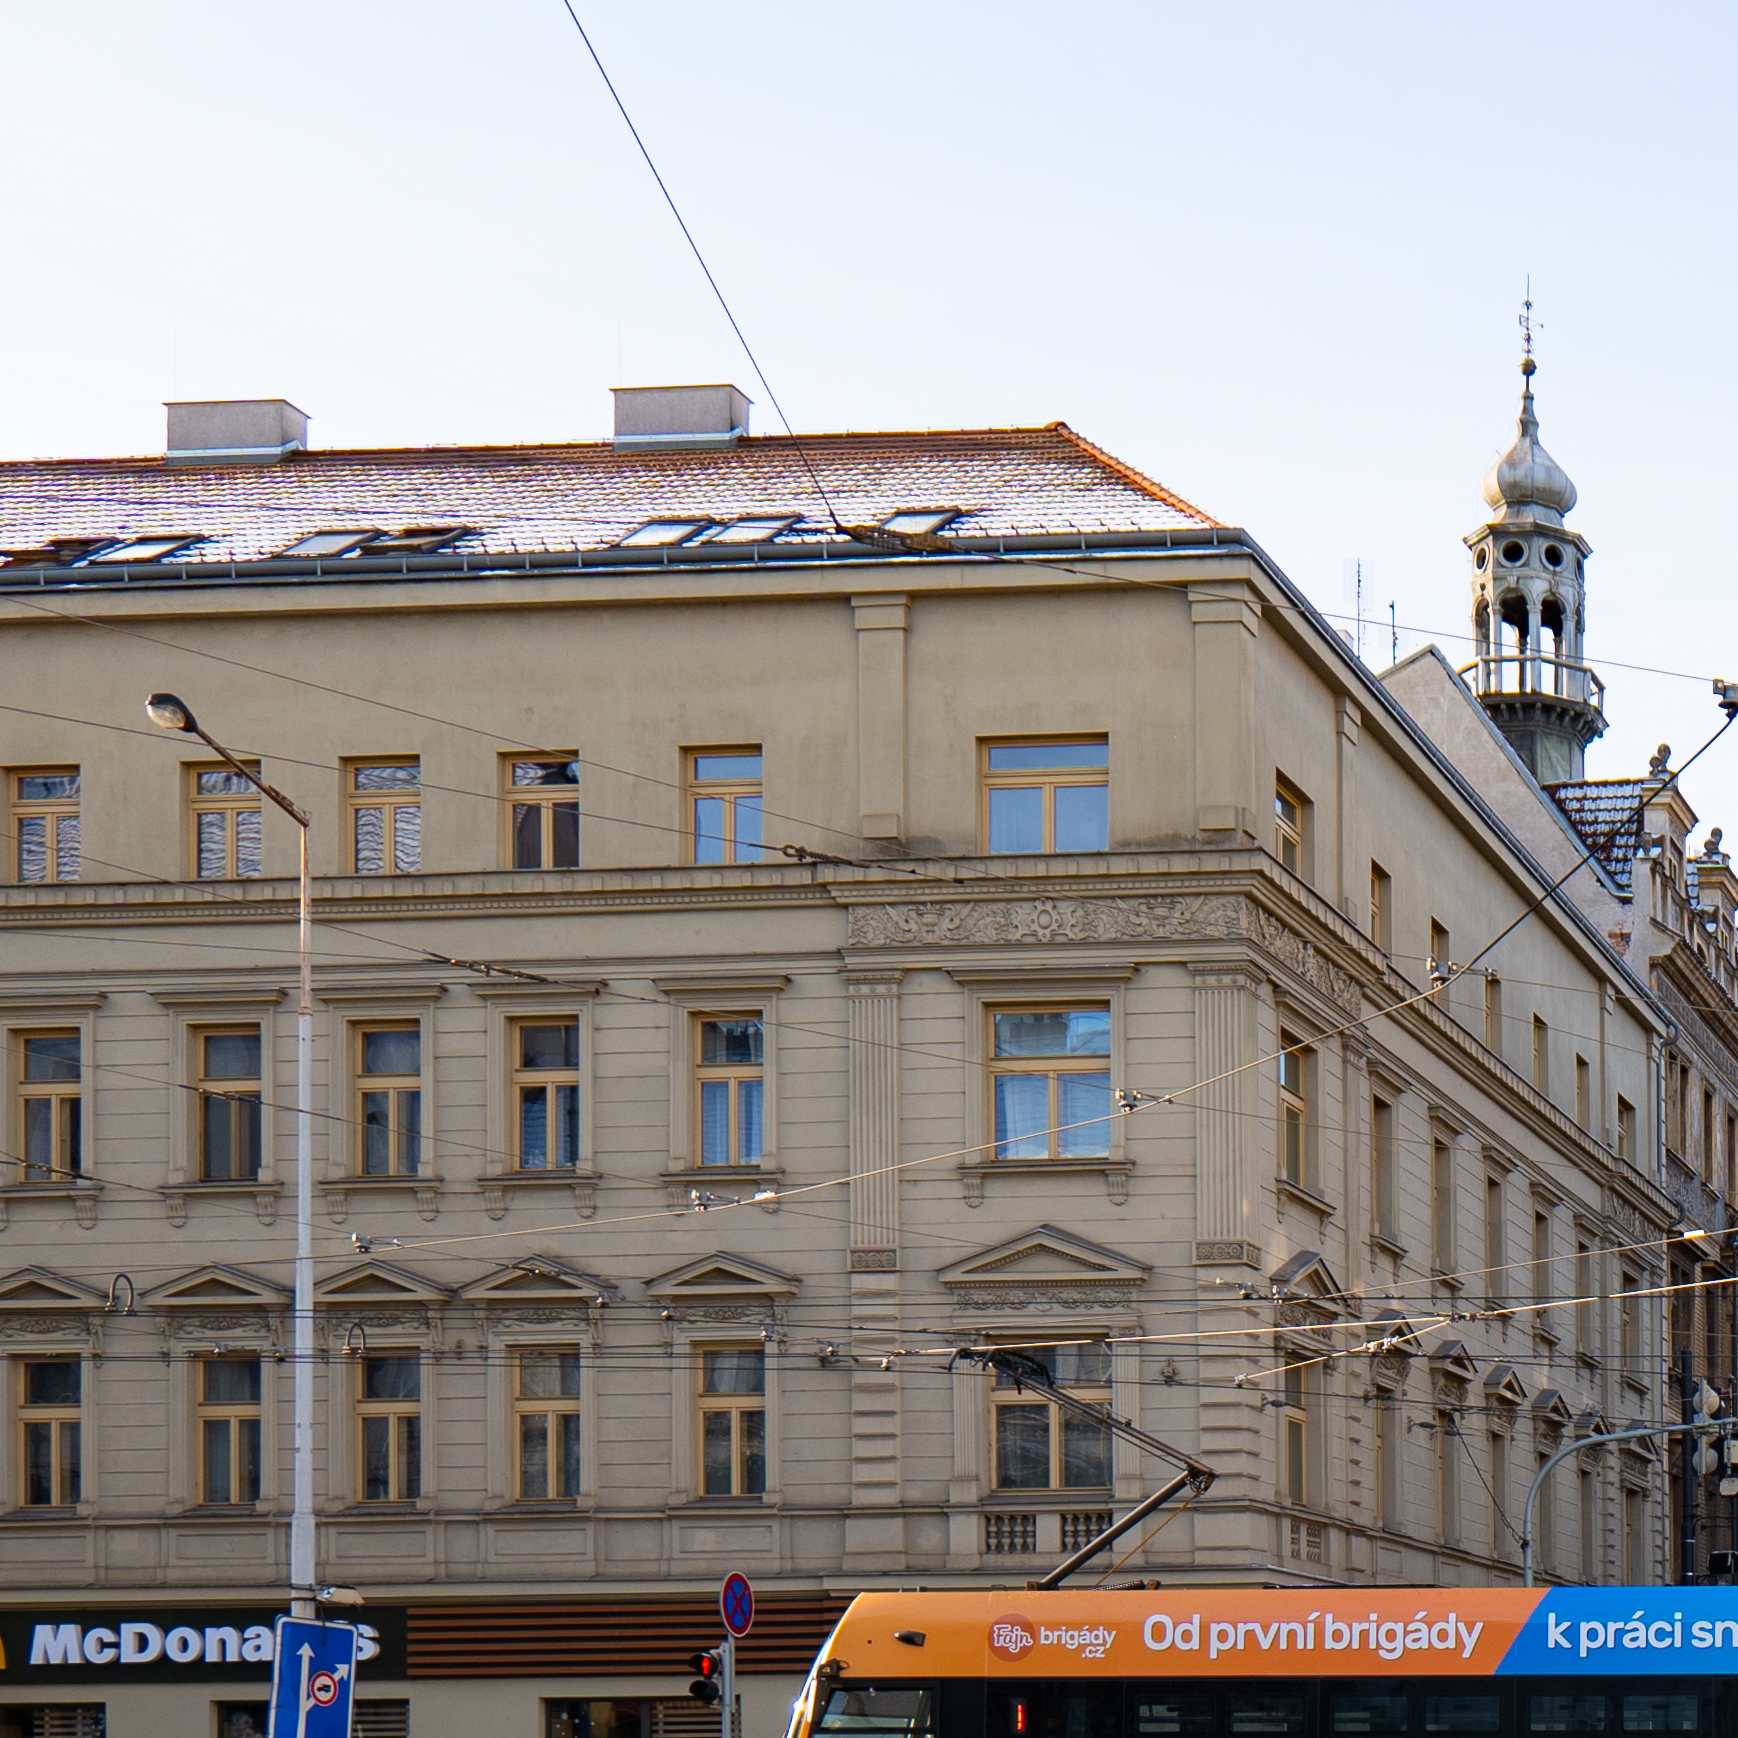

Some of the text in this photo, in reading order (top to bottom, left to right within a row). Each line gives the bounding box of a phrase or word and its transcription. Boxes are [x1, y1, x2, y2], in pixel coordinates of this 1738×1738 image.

[993, 1624, 1116, 1653] Fajn brigády
[1081, 1646, 1105, 1658] .cz
[1144, 1611, 1484, 1660] Od první brigády
[1547, 1613, 1572, 1648] k
[1580, 1611, 1682, 1657] práci
